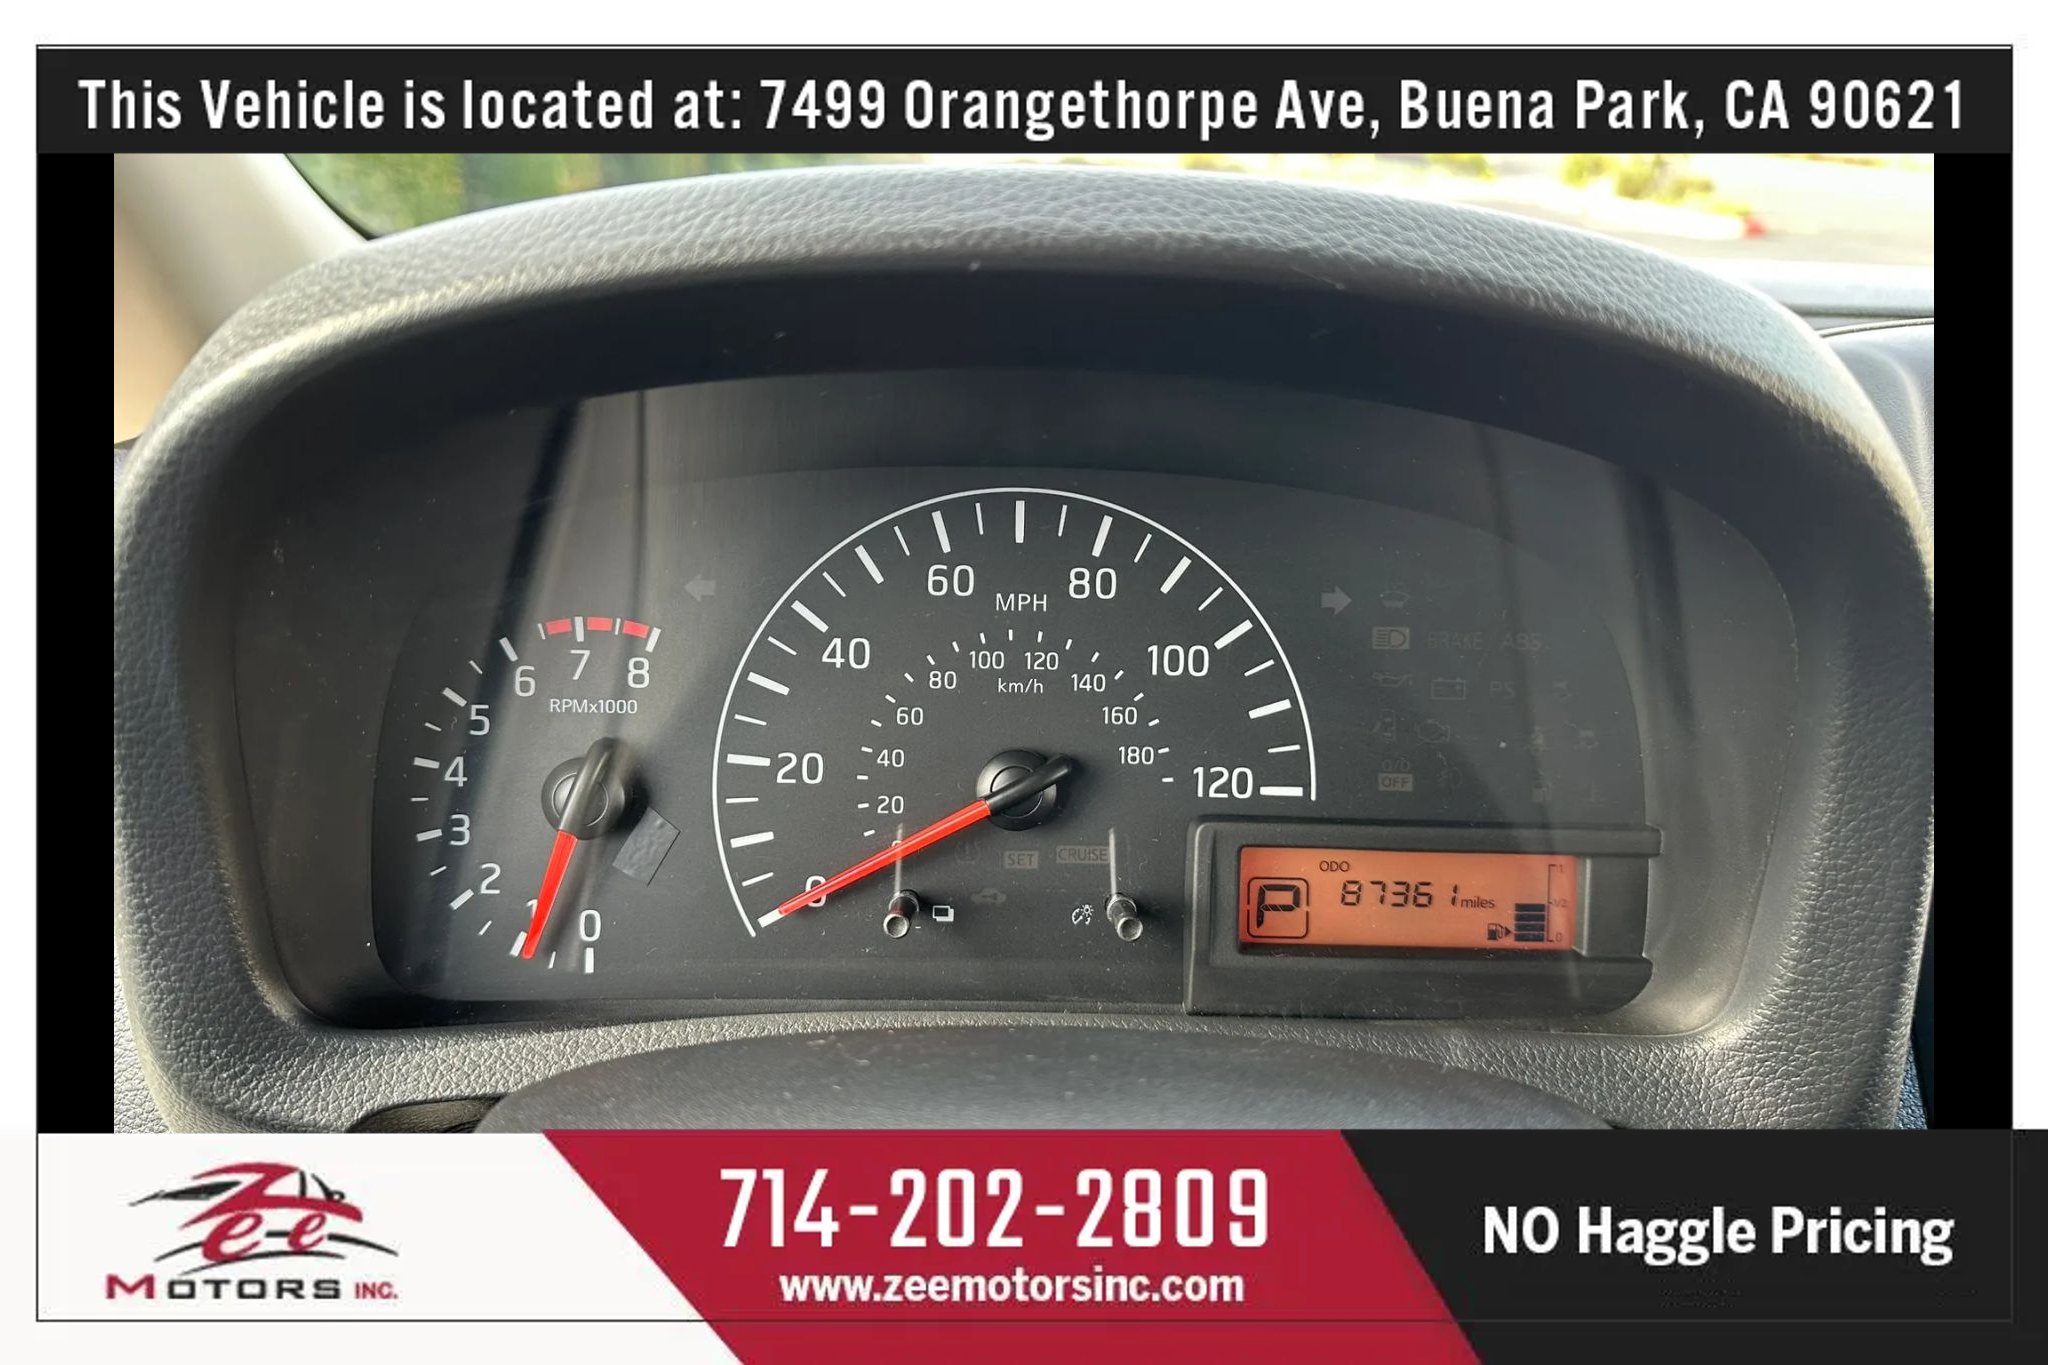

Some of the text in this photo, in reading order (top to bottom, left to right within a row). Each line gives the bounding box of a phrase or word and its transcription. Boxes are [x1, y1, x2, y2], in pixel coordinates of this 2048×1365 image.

[928, 565, 974, 596] 60
[1069, 568, 1116, 599] 80
[997, 594, 1046, 611] MPH
[822, 638, 869, 668] 40
[970, 651, 1004, 669] 100
[1025, 652, 1058, 670] 120
[1148, 645, 1209, 676] 100
[571, 650, 590, 680] 7
[628, 658, 649, 688] 8
[515, 666, 535, 696] 6
[930, 671, 956, 689] 80
[999, 678, 1043, 693] km/h
[1072, 674, 1105, 691] 140
[551, 699, 637, 713] RPMx1000
[897, 707, 923, 725] 60
[1103, 707, 1137, 724] 160
[470, 705, 489, 735] 5
[877, 750, 904, 767] 40
[1119, 747, 1153, 764] 180
[445, 757, 467, 786] 4
[777, 753, 823, 784] 20
[1194, 767, 1253, 798] 120
[1381, 777, 1410, 788] OFF
[878, 796, 903, 813] 20
[451, 815, 470, 845] 3
[1007, 853, 1034, 867] SET
[1058, 849, 1109, 862] CRUISE
[1319, 860, 1350, 873] ODO
[481, 863, 500, 894] 2
[1257, 884, 1301, 928] P
[1341, 880, 1496, 910] 87361 miles
[580, 910, 601, 941] 0
